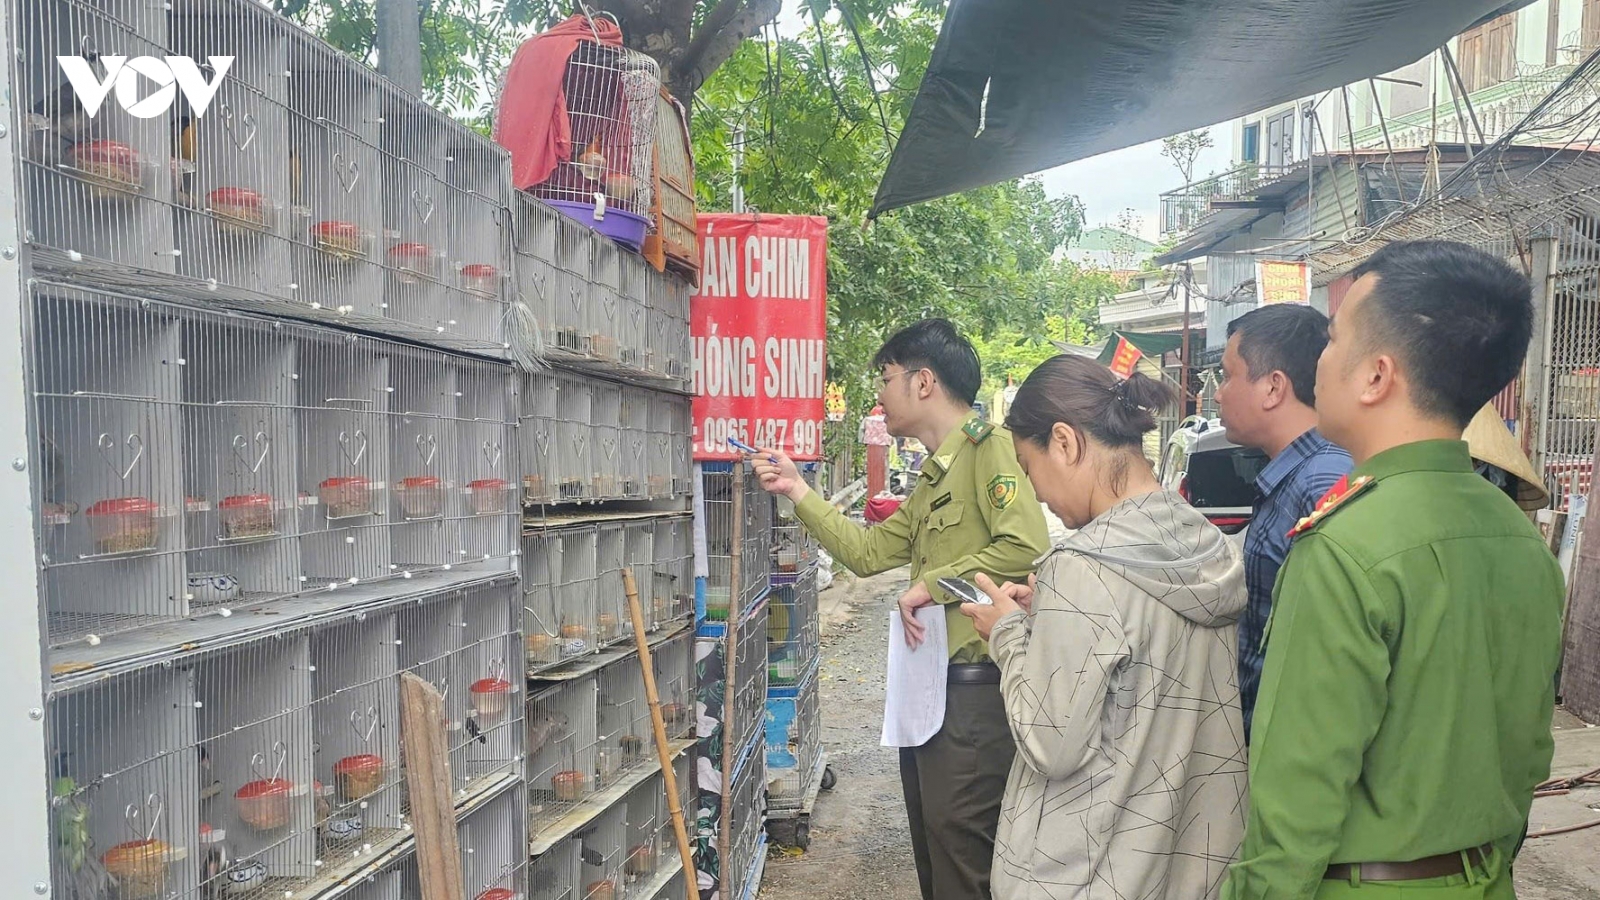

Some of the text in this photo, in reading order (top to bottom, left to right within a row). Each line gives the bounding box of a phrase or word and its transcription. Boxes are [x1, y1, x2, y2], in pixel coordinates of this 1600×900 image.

[689, 222, 809, 300] ÁN CHIM
[690, 323, 823, 399] HÓNG SINH
[704, 417, 749, 454] 0965
[754, 418, 788, 453] 487
[794, 419, 823, 456] 991
